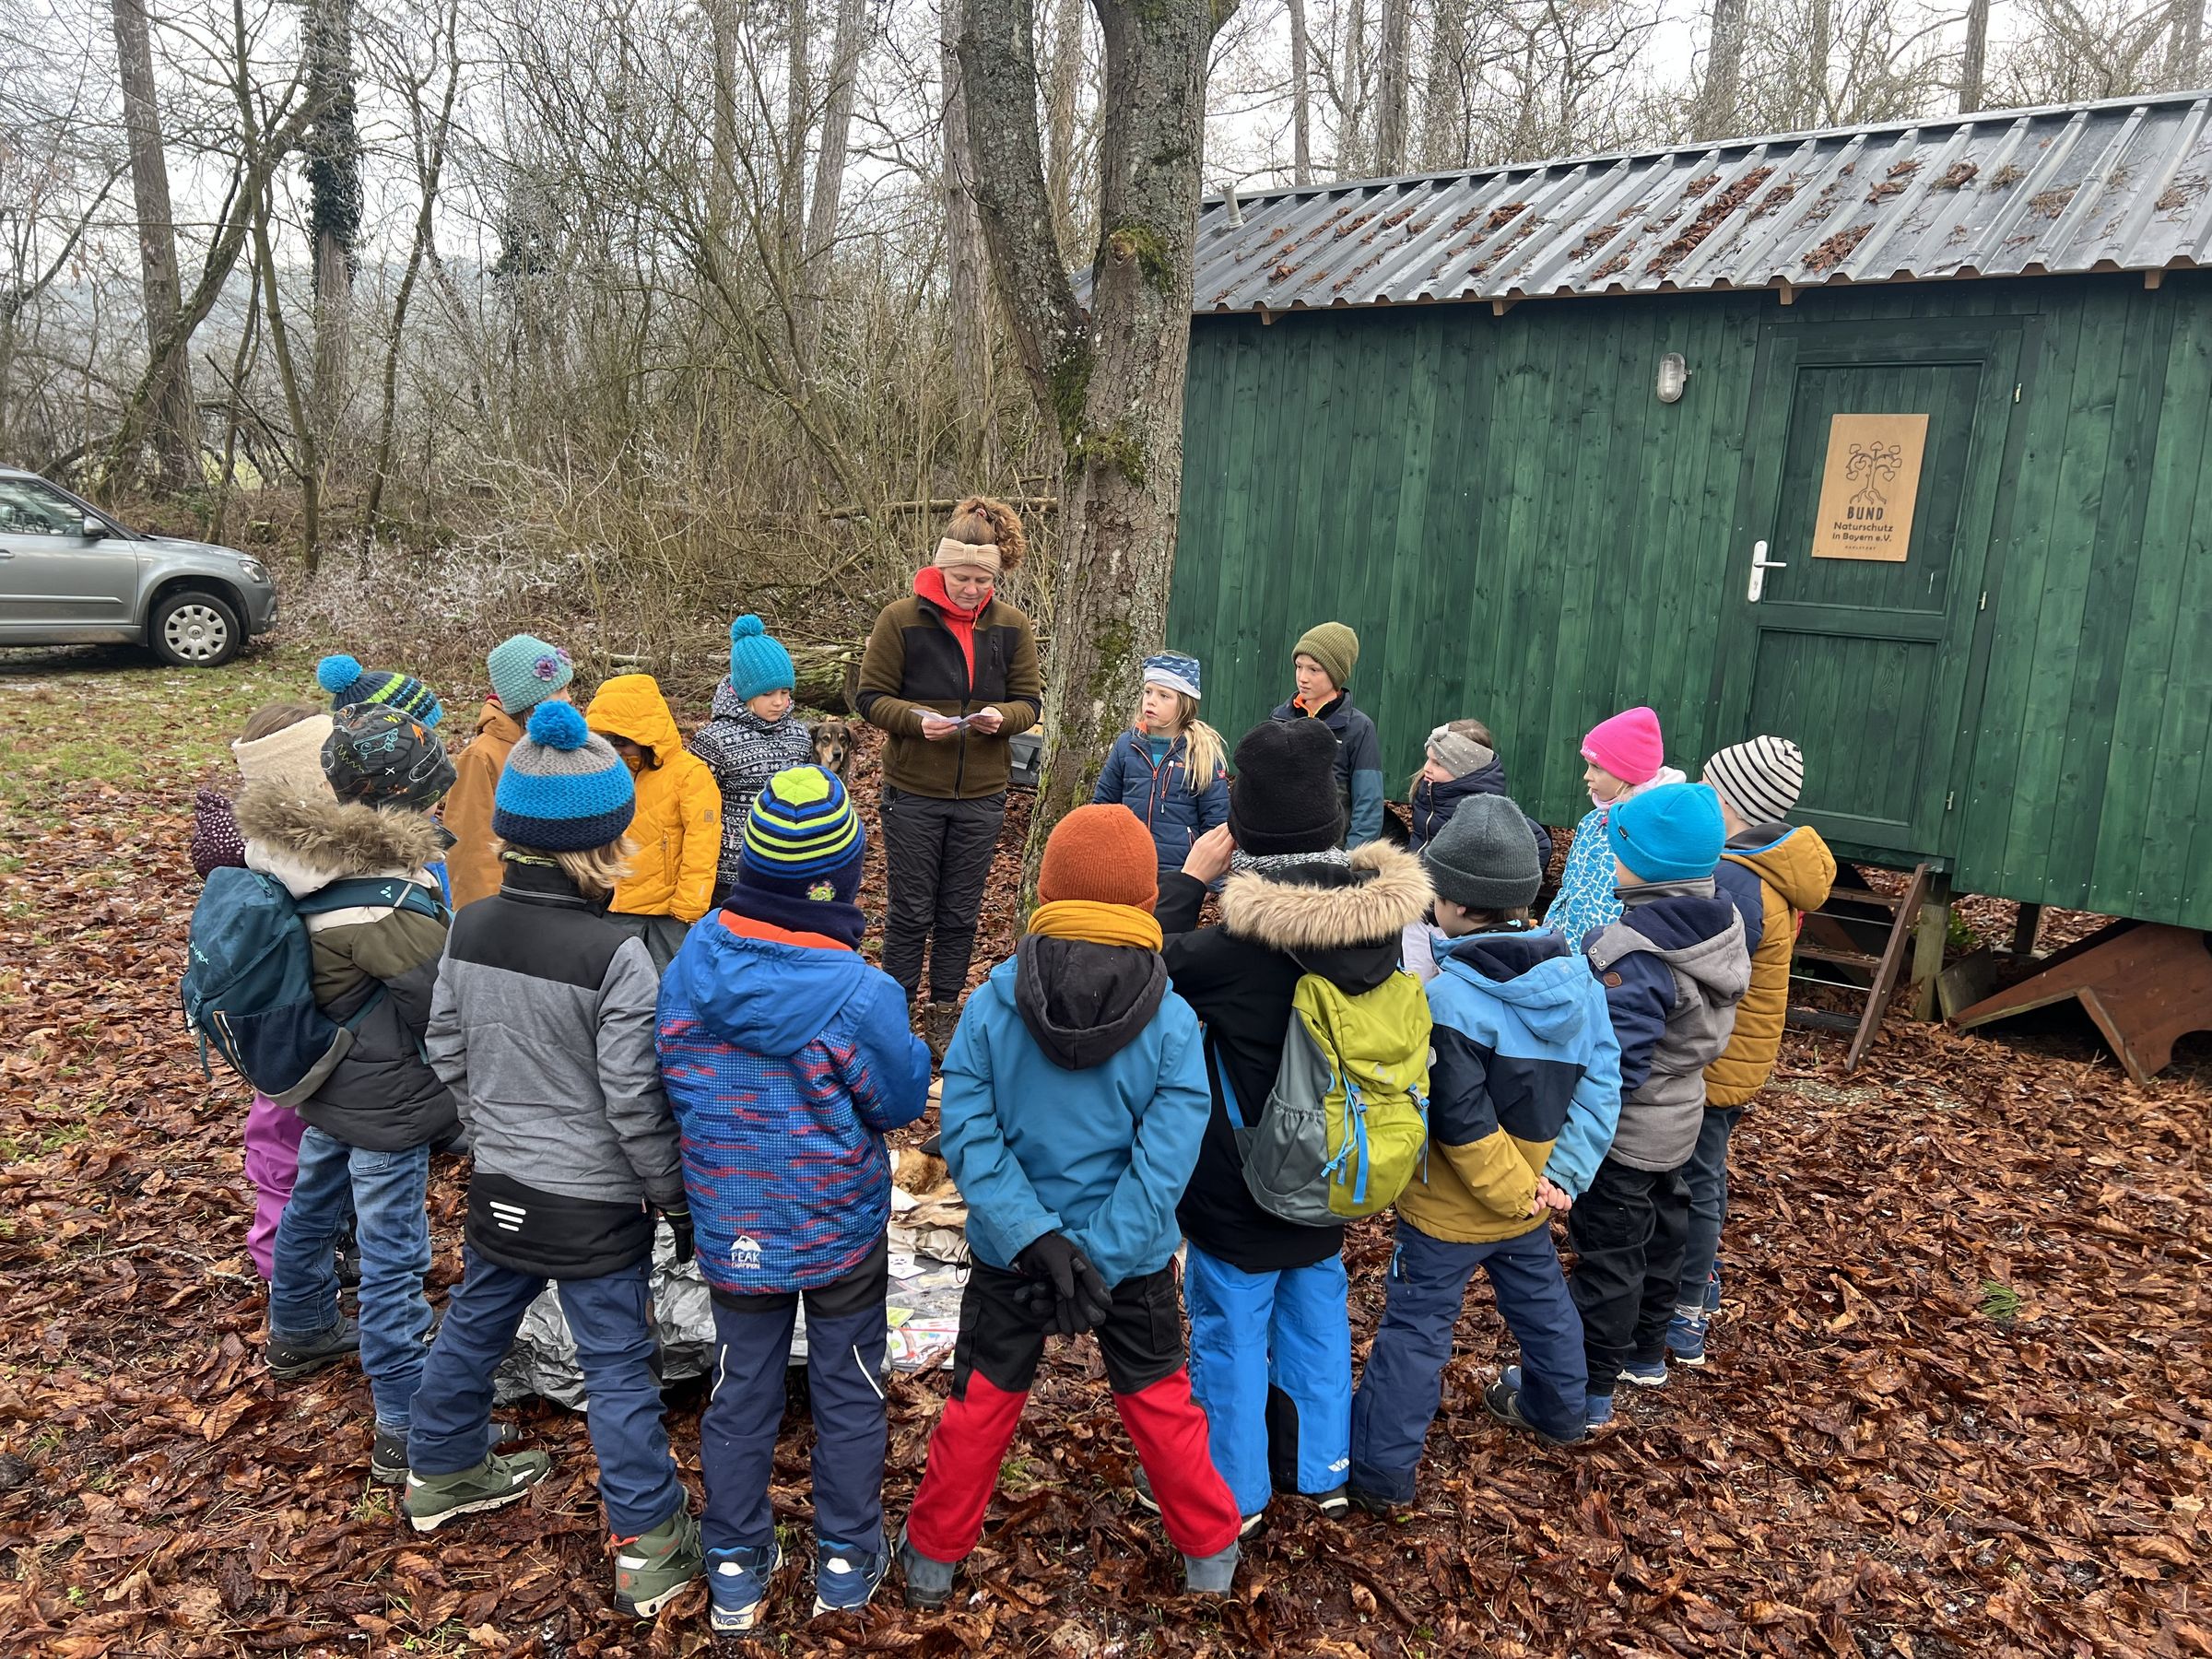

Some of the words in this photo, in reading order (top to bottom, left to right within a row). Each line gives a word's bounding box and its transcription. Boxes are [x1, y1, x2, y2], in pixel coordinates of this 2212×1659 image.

[1847, 506, 1884, 520] BUND
[1833, 522, 1893, 532] Naturschutz
[1842, 532, 1873, 542] Bayern
[1876, 534, 1892, 542] e.V.
[731, 1252, 759, 1263] PEAK
